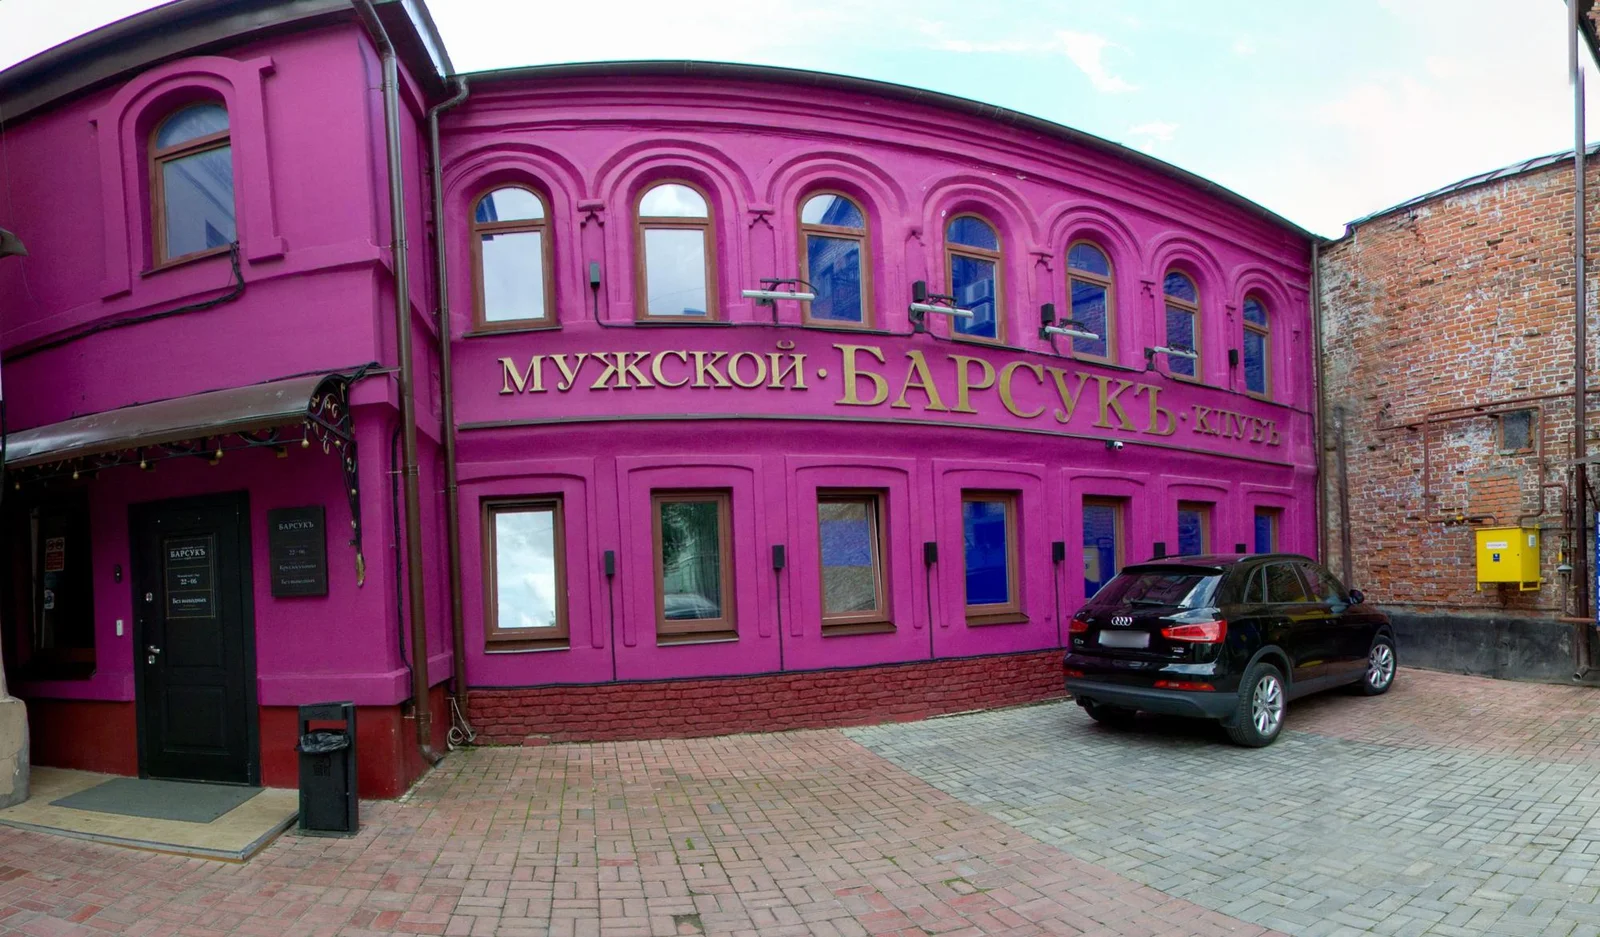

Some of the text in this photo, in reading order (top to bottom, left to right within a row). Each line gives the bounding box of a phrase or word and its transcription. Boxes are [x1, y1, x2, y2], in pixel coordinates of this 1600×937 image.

[498, 340, 1280, 446] МУЖСКОЙ БАРСУКЪ КЛУБЪ
[279, 521, 314, 531] БАРСУКЪ
[170, 548, 206, 558] БАРСУКЪ
